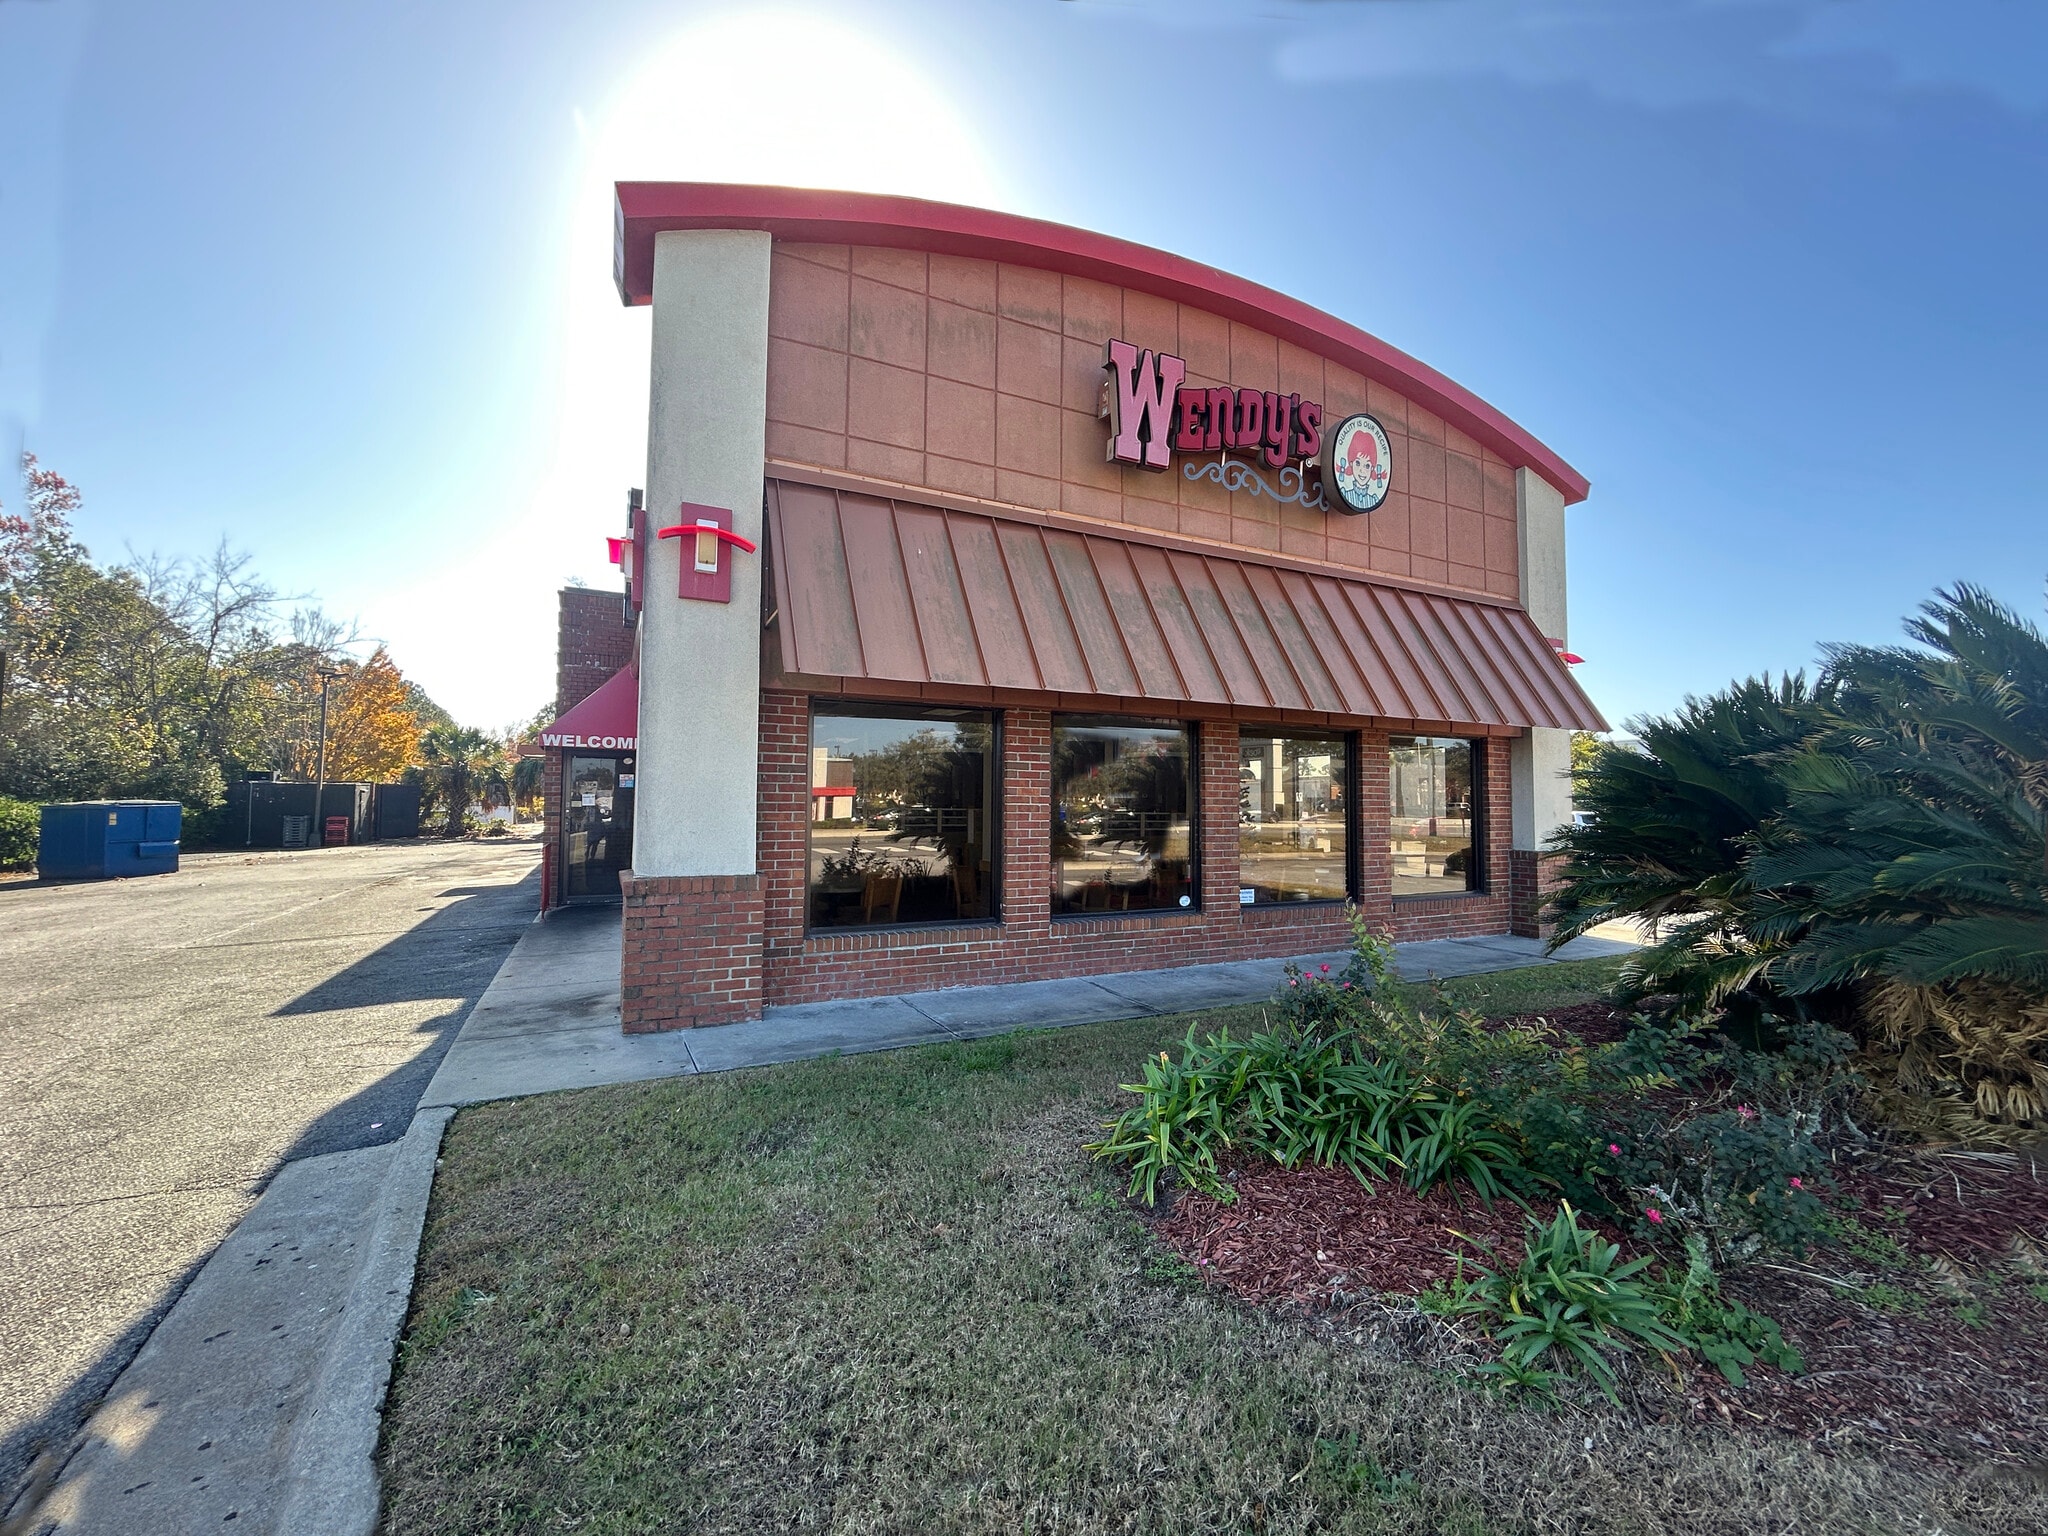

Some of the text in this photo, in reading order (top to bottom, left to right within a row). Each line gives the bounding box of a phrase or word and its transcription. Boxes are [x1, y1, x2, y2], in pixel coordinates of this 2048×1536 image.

[1338, 422, 1356, 446] QUALITY
[1363, 421, 1375, 431] OUR
[1375, 431, 1388, 456] RECIPE
[541, 733, 638, 749] WELCOM
